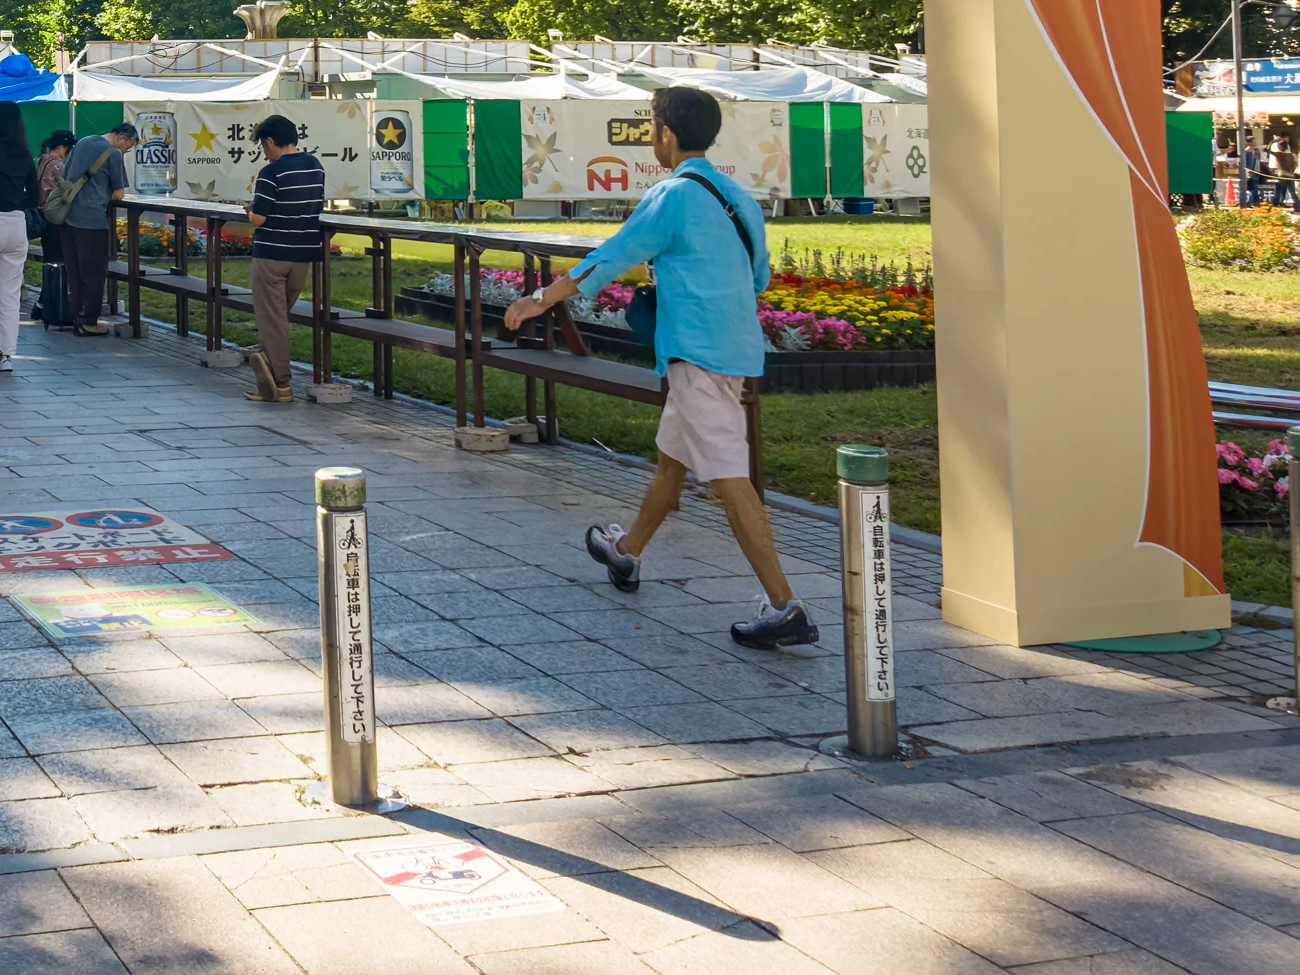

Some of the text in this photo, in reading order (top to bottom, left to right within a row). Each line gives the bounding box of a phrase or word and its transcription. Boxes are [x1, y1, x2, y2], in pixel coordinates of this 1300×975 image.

[136, 148, 177, 165] CLASSIC
[187, 157, 221, 165] SAPPORO
[371, 151, 412, 162] SAPPORO
[586, 169, 629, 192] NH
